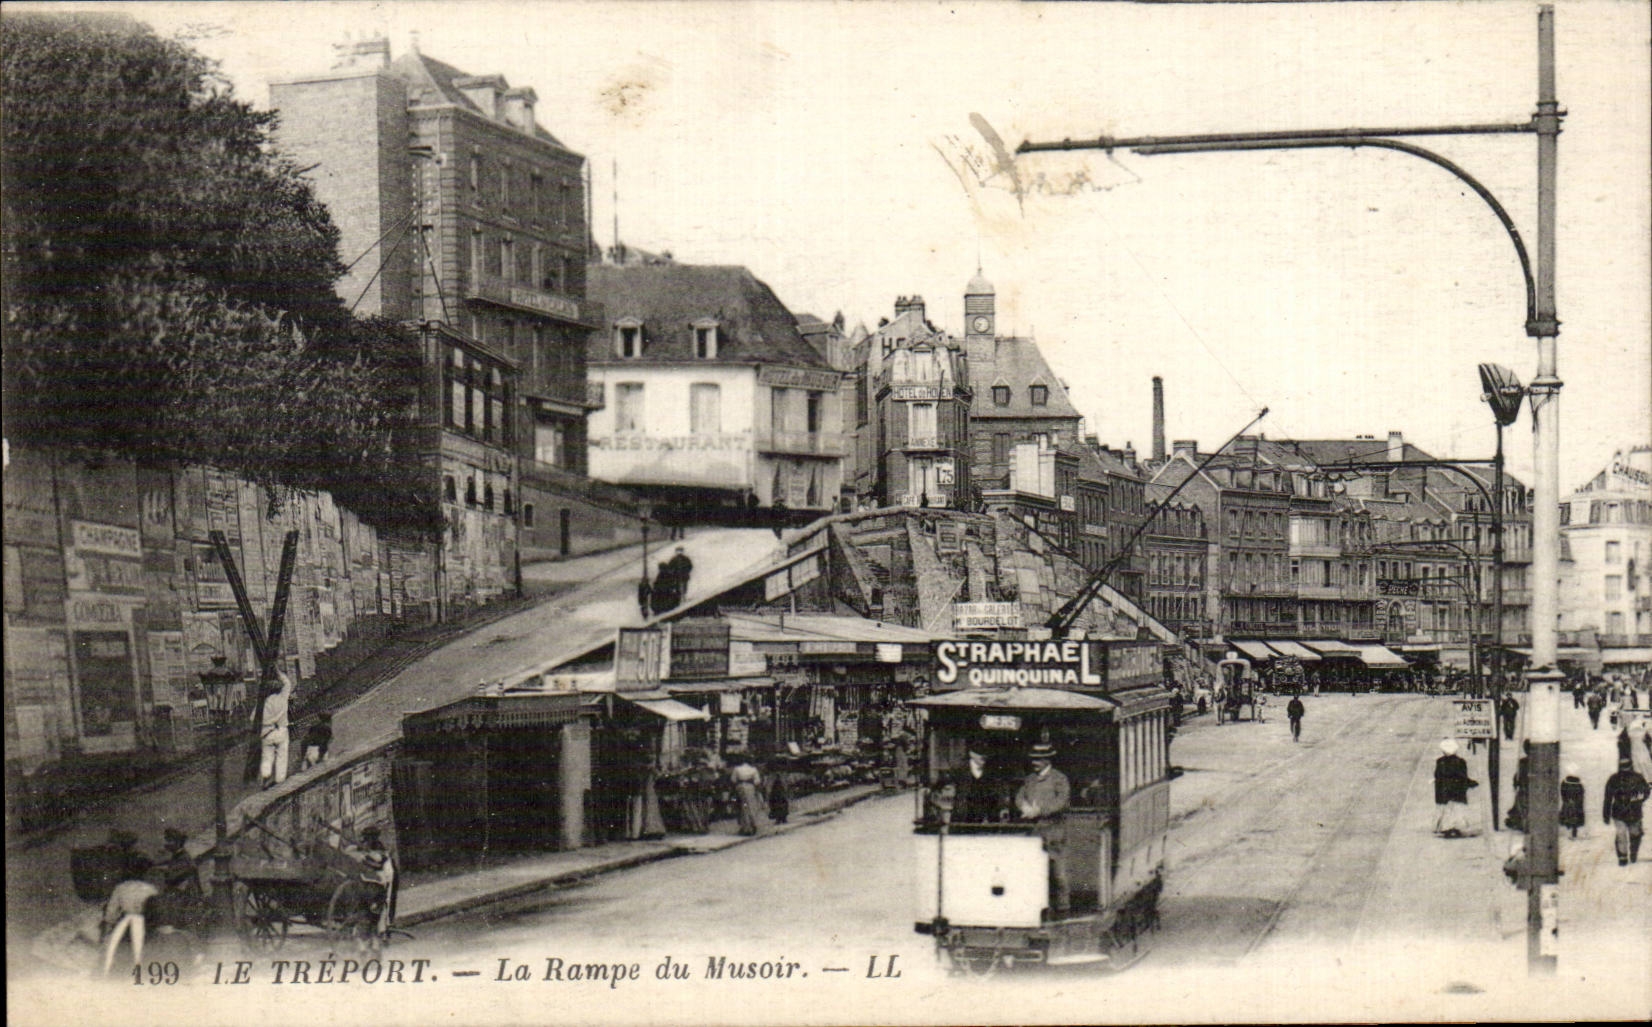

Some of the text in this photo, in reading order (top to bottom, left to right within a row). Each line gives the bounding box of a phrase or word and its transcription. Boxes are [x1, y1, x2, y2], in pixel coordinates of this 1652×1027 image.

[599, 436, 746, 452] RESTAURANT
[970, 640, 1102, 685] RAPHAËL
[969, 669, 1079, 687] QUINQUINA
[1462, 703, 1482, 712] AVIS
